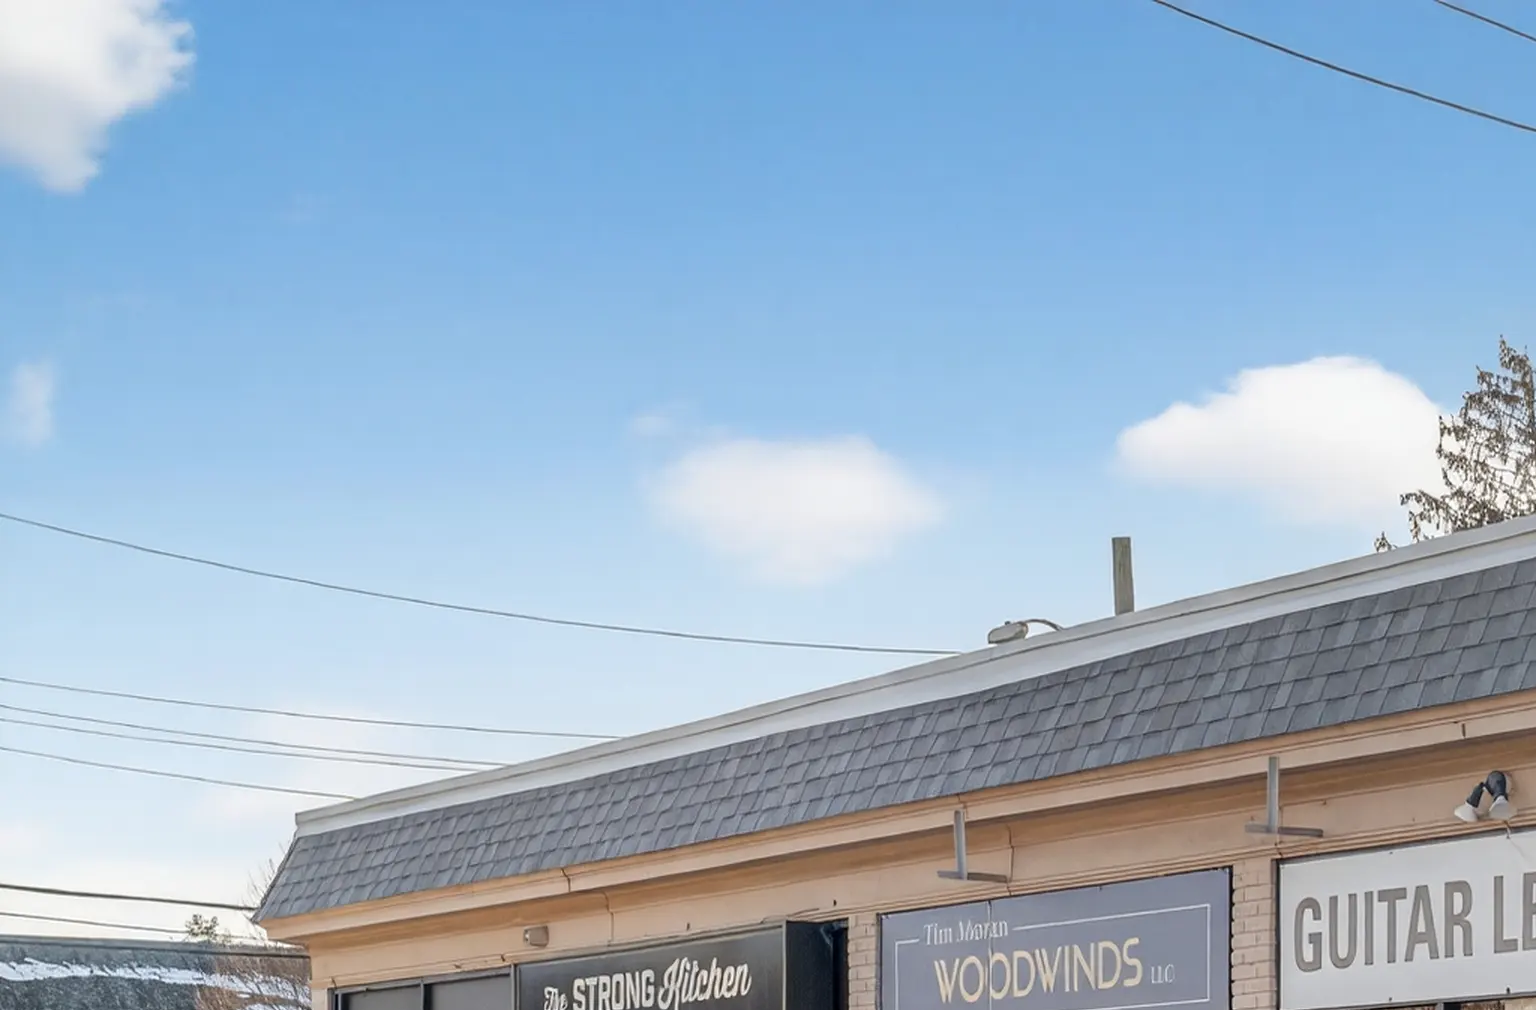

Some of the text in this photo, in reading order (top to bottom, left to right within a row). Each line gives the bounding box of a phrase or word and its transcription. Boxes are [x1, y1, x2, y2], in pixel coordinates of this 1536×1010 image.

[923, 923, 952, 946] Tim
[1294, 880, 1474, 973] GUITAR
[934, 937, 1143, 1003] WOODWINDS
